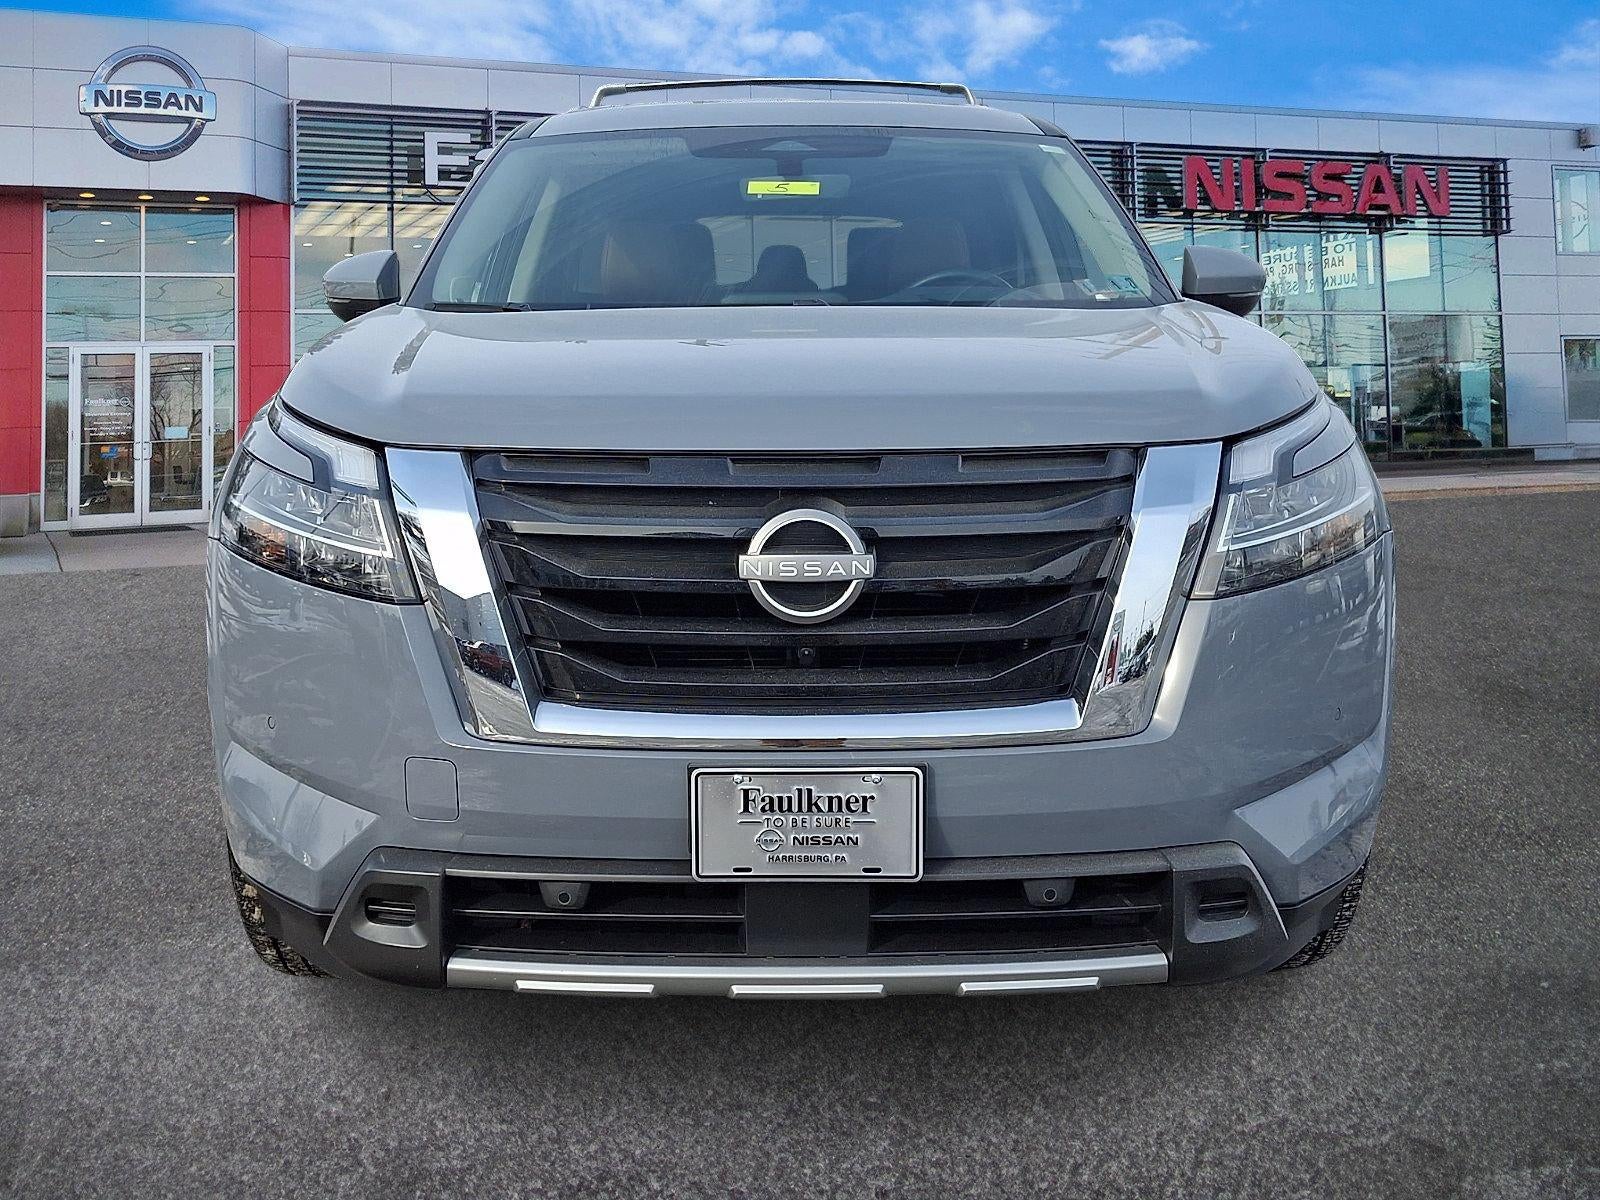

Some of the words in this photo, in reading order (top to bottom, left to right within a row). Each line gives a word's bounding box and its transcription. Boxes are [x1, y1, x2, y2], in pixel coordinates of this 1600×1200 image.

[93, 88, 204, 114] NISSAN
[1183, 156, 1450, 216] NISSAN
[743, 560, 870, 577] NISSAN
[739, 787, 876, 814] Faulkner
[765, 817, 784, 828] TO
[791, 817, 808, 828] BE
[815, 817, 851, 828] SURE
[792, 835, 859, 846] NISSAN
[767, 855, 833, 863] HARRISBURG,
[834, 855, 847, 863] PA
